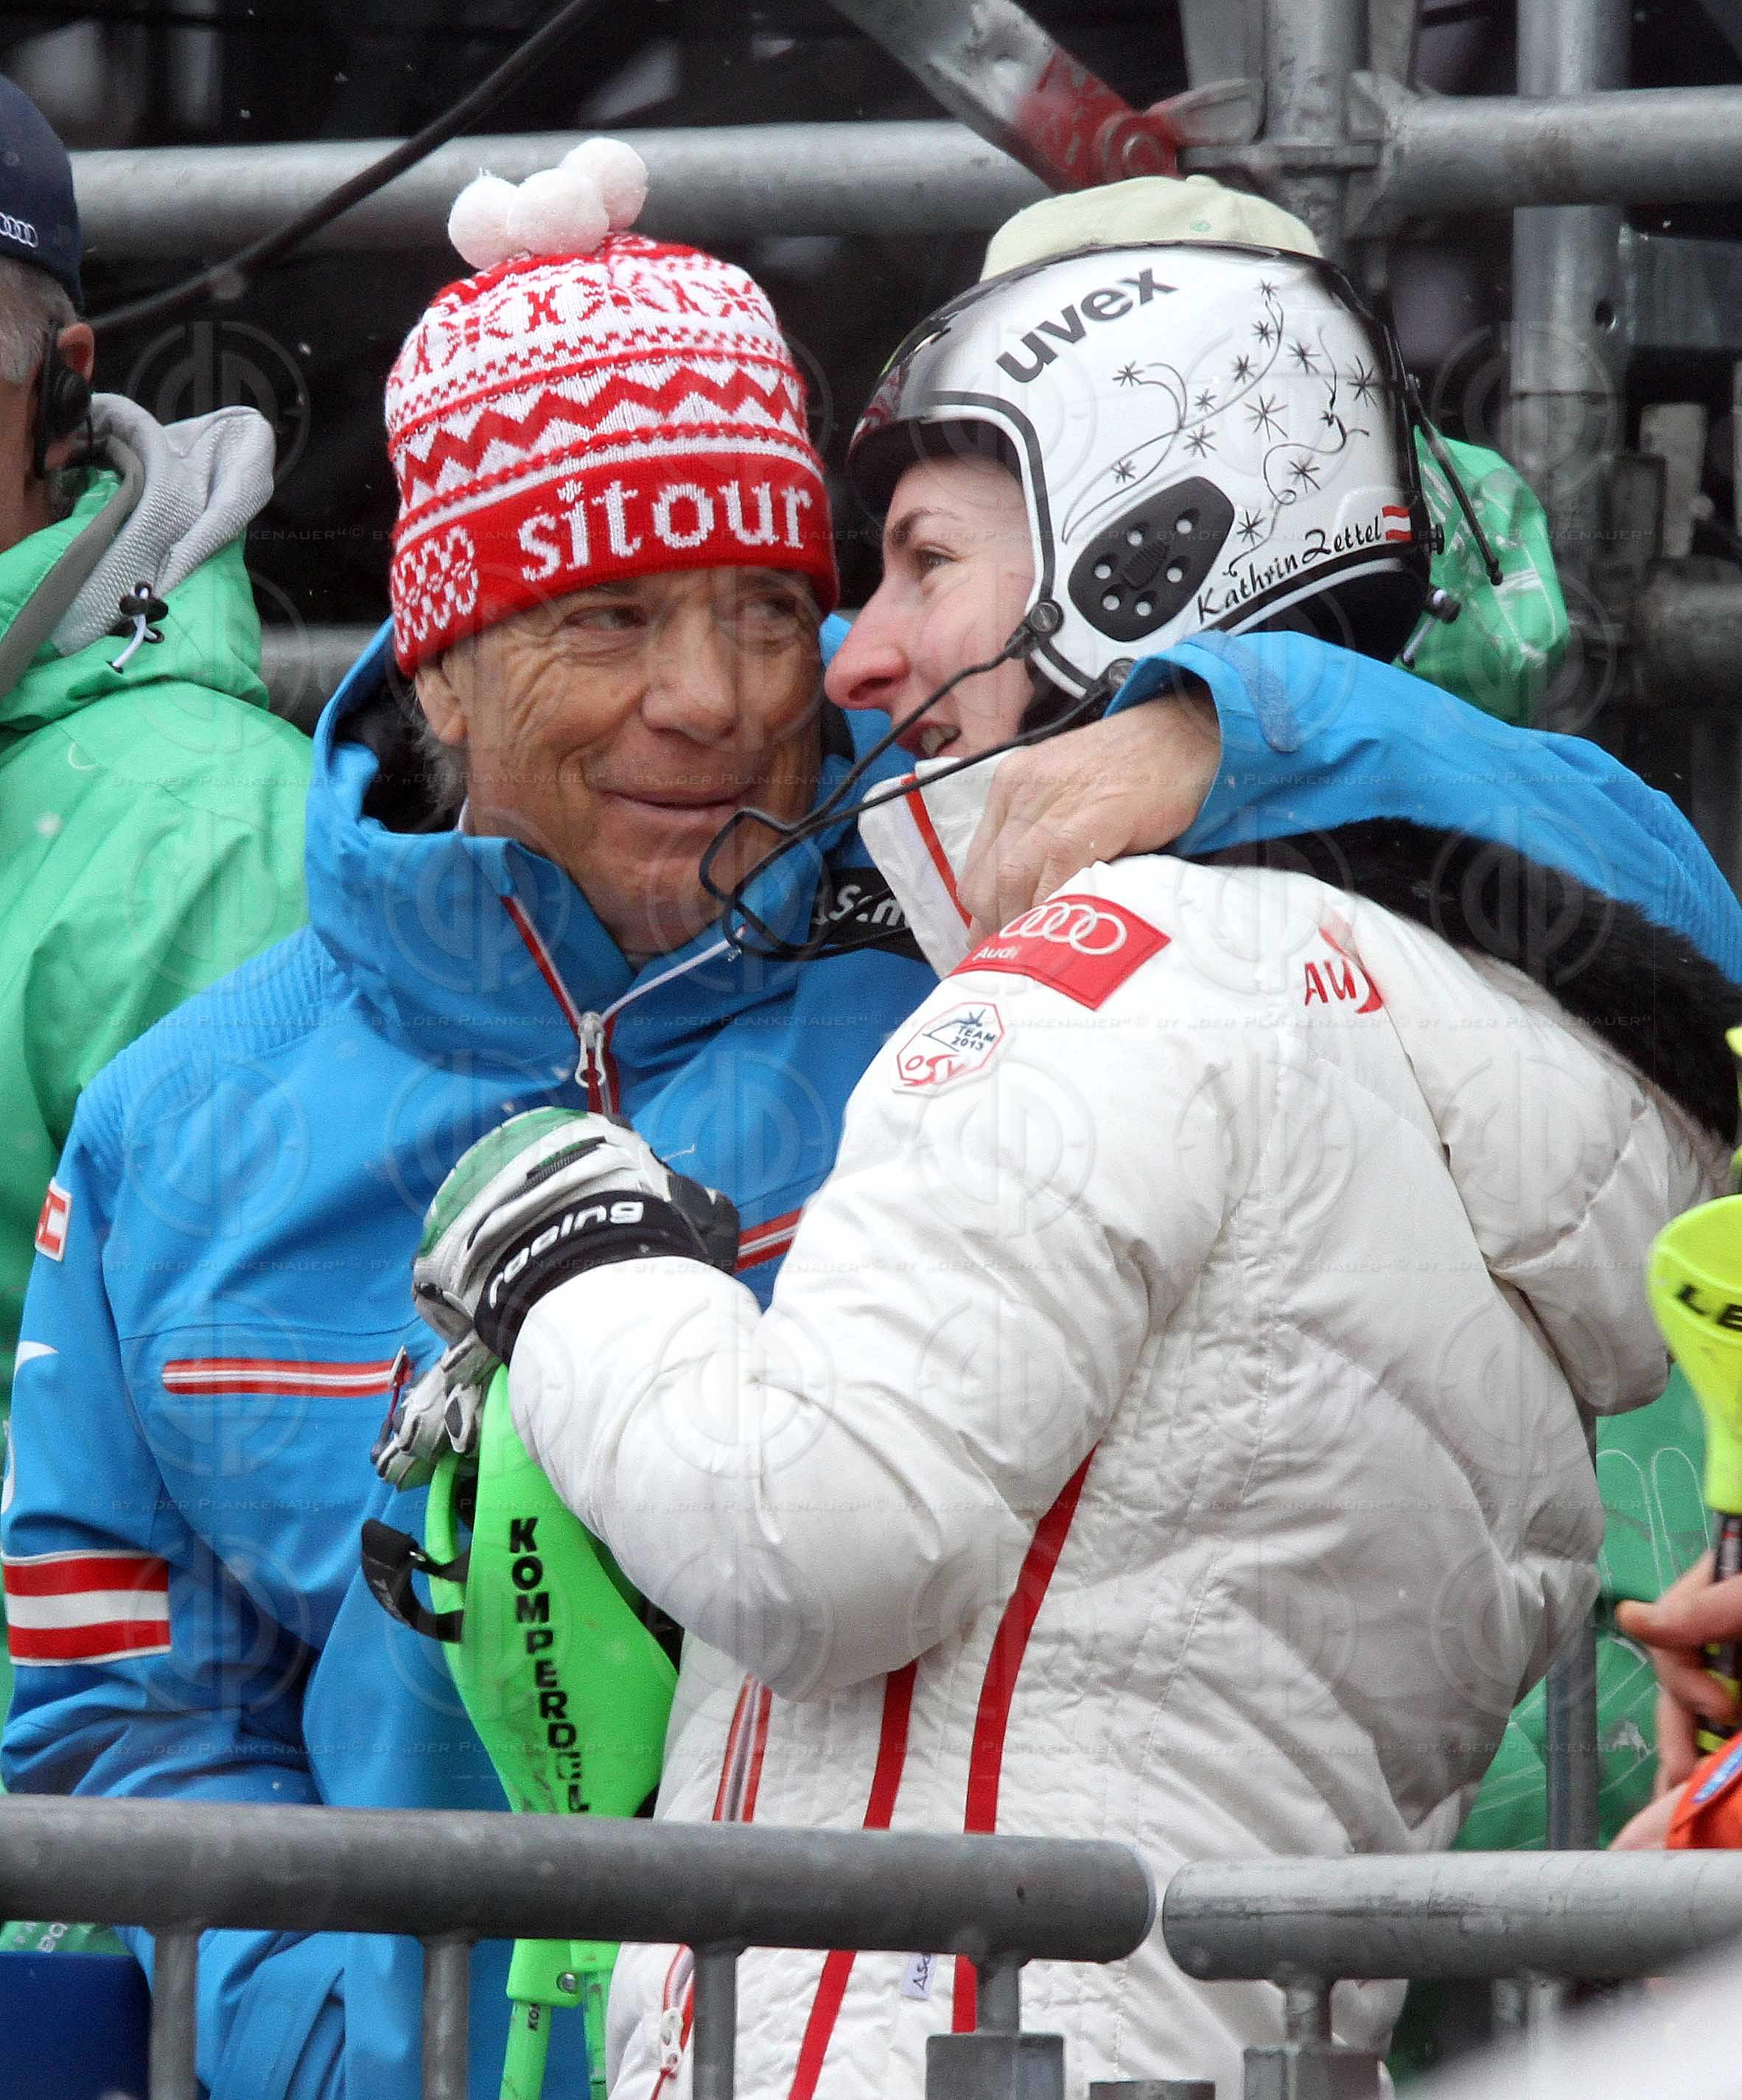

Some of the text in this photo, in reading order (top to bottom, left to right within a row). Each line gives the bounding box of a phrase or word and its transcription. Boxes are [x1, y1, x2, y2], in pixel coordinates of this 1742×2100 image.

[996, 267, 1179, 383] uvex
[517, 479, 813, 582] sitour
[1197, 553, 1298, 624] Kathrin
[951, 1036, 984, 1051] 2013
[957, 1024, 996, 1042] TEAM
